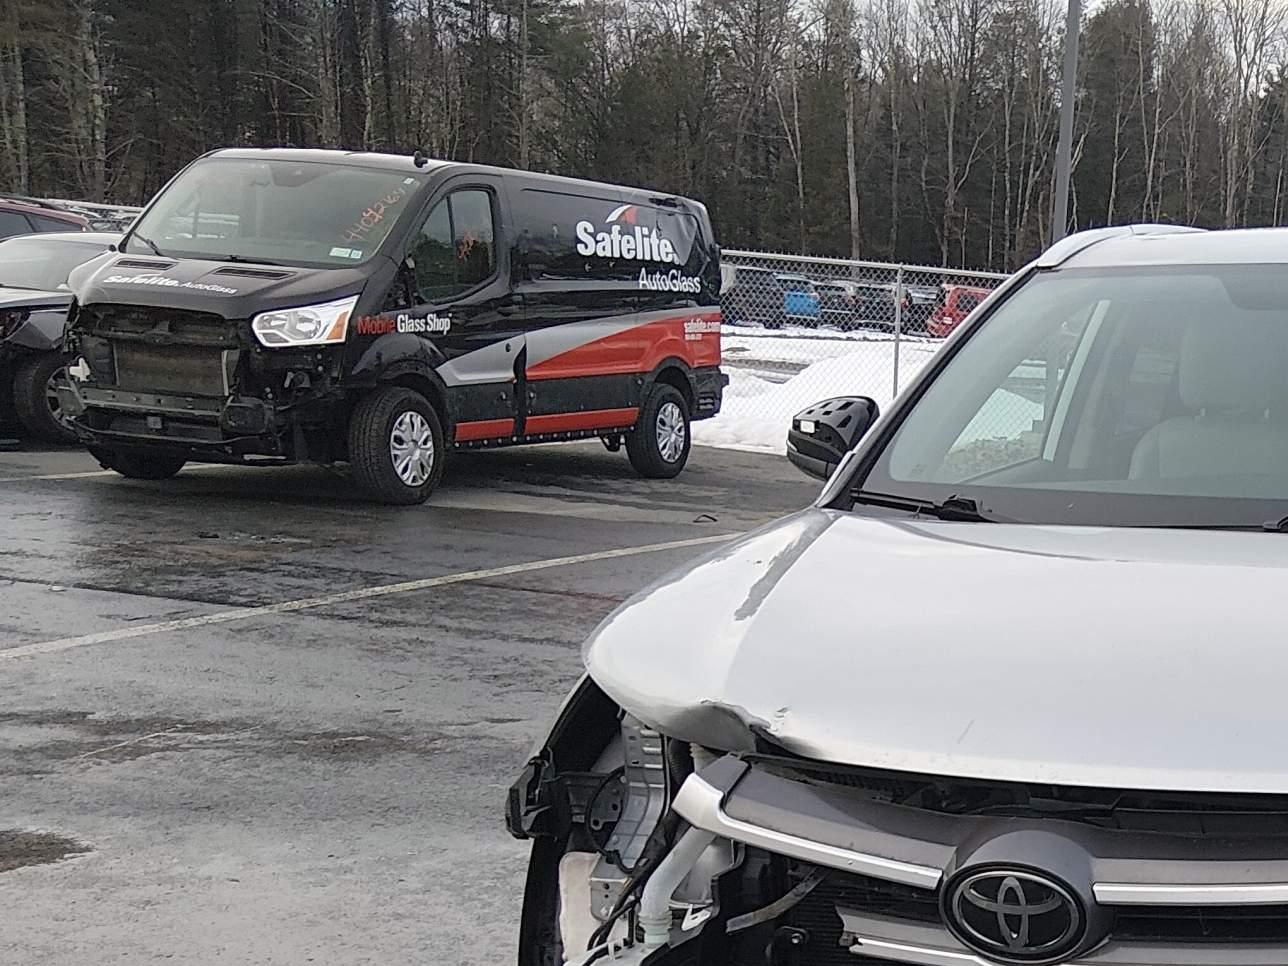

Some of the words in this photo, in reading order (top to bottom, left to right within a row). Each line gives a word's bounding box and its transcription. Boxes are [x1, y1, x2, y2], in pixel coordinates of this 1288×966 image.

[179, 281, 238, 294] AutoGlass
[638, 267, 701, 293] AutoGlass
[357, 315, 396, 334] Mobile
[397, 313, 426, 333] Glass
[426, 313, 451, 335] Shop
